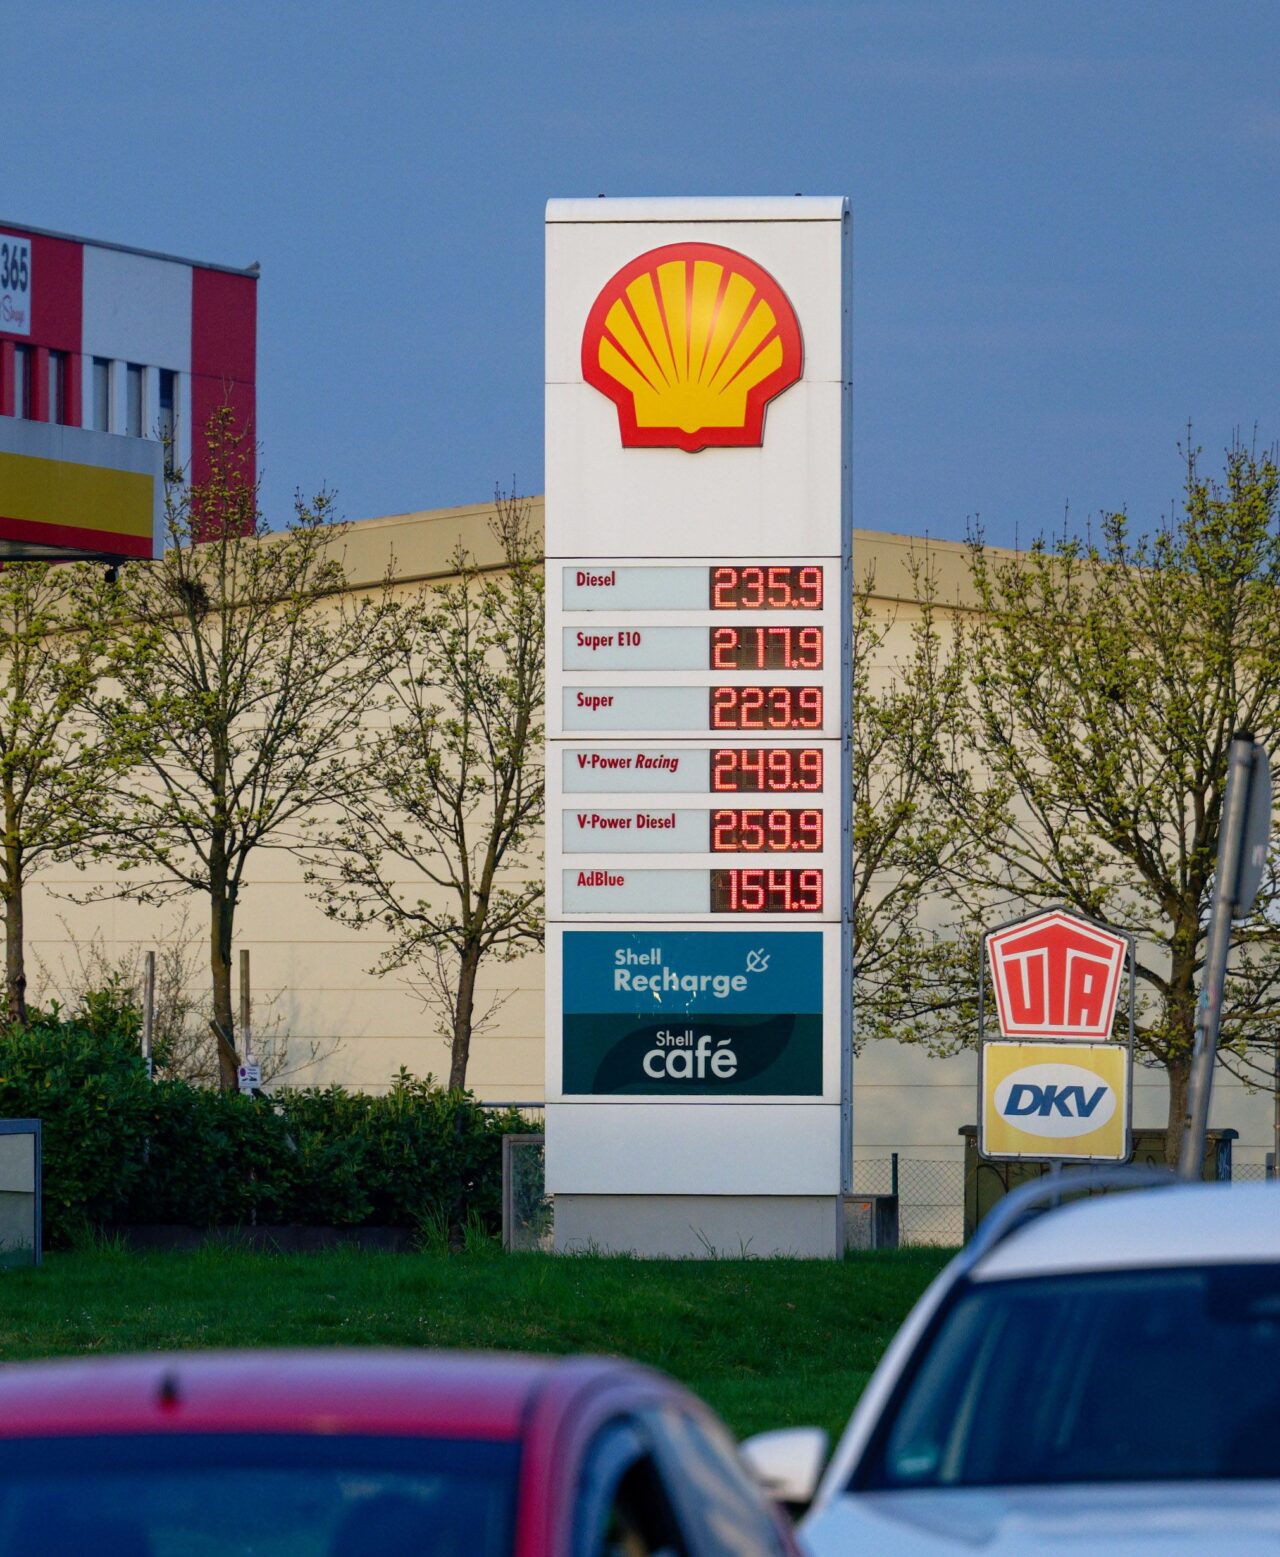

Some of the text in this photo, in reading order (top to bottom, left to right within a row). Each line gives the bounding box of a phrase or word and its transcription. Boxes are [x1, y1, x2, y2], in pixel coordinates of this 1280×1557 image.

[576, 567, 822, 608] Diesel 235.9
[576, 628, 822, 668] Super E10 217.9
[576, 687, 822, 727] Super 223.9
[577, 749, 822, 789] V-Power Racing 249.9
[577, 810, 822, 850] V-Power Diesel 259.9
[577, 870, 822, 909] AdBlue 154.9
[615, 948, 661, 965] Shell
[1001, 923, 1114, 1027] UTA
[614, 967, 748, 998] Recharge
[643, 1035, 738, 1079] café
[656, 1030, 693, 1046] Shell
[1003, 1084, 1108, 1118] DKV
